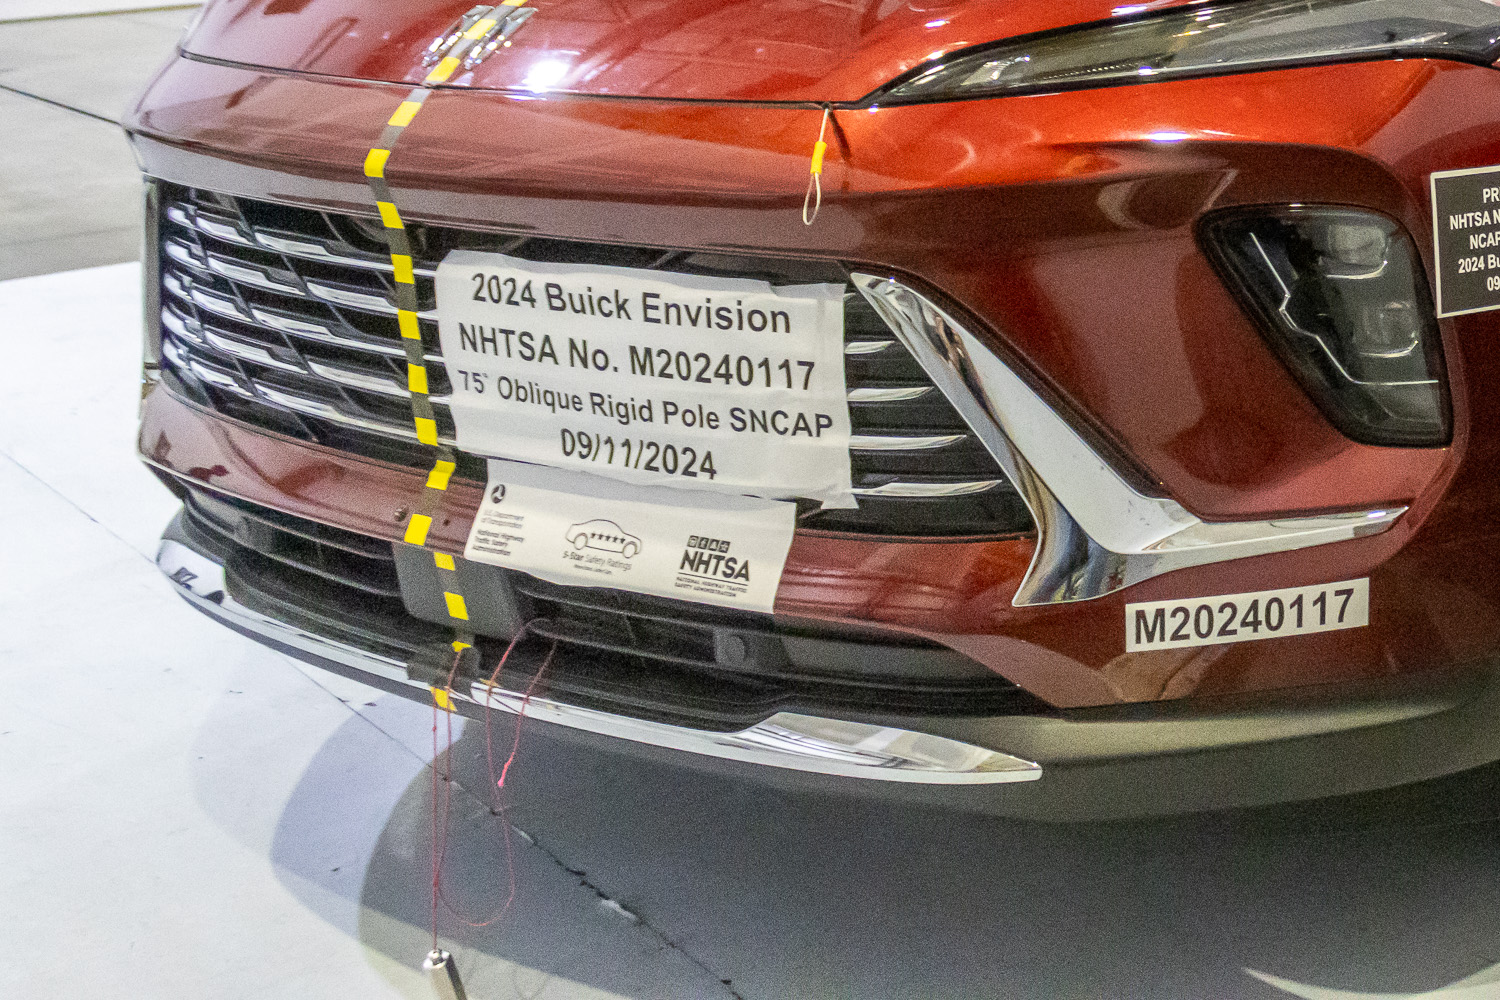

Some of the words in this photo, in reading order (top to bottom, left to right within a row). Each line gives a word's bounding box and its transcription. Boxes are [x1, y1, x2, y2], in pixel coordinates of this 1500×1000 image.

[1449, 212, 1491, 230] NHTSA
[1458, 257, 1485, 274] 2024
[472, 272, 537, 308] 2024
[545, 282, 632, 321] Buick
[642, 292, 792, 333] Envision
[458, 322, 559, 366] NHTSA
[568, 337, 619, 373] No.
[628, 345, 815, 391] M20240117
[497, 375, 584, 414] Oblique
[589, 391, 653, 427] Rigid
[662, 400, 721, 431] Pole
[729, 406, 834, 438] SNCAP
[560, 427, 718, 480] 09/11/2024
[679, 549, 750, 581] NHTSA
[1134, 588, 1355, 645] M20240117
